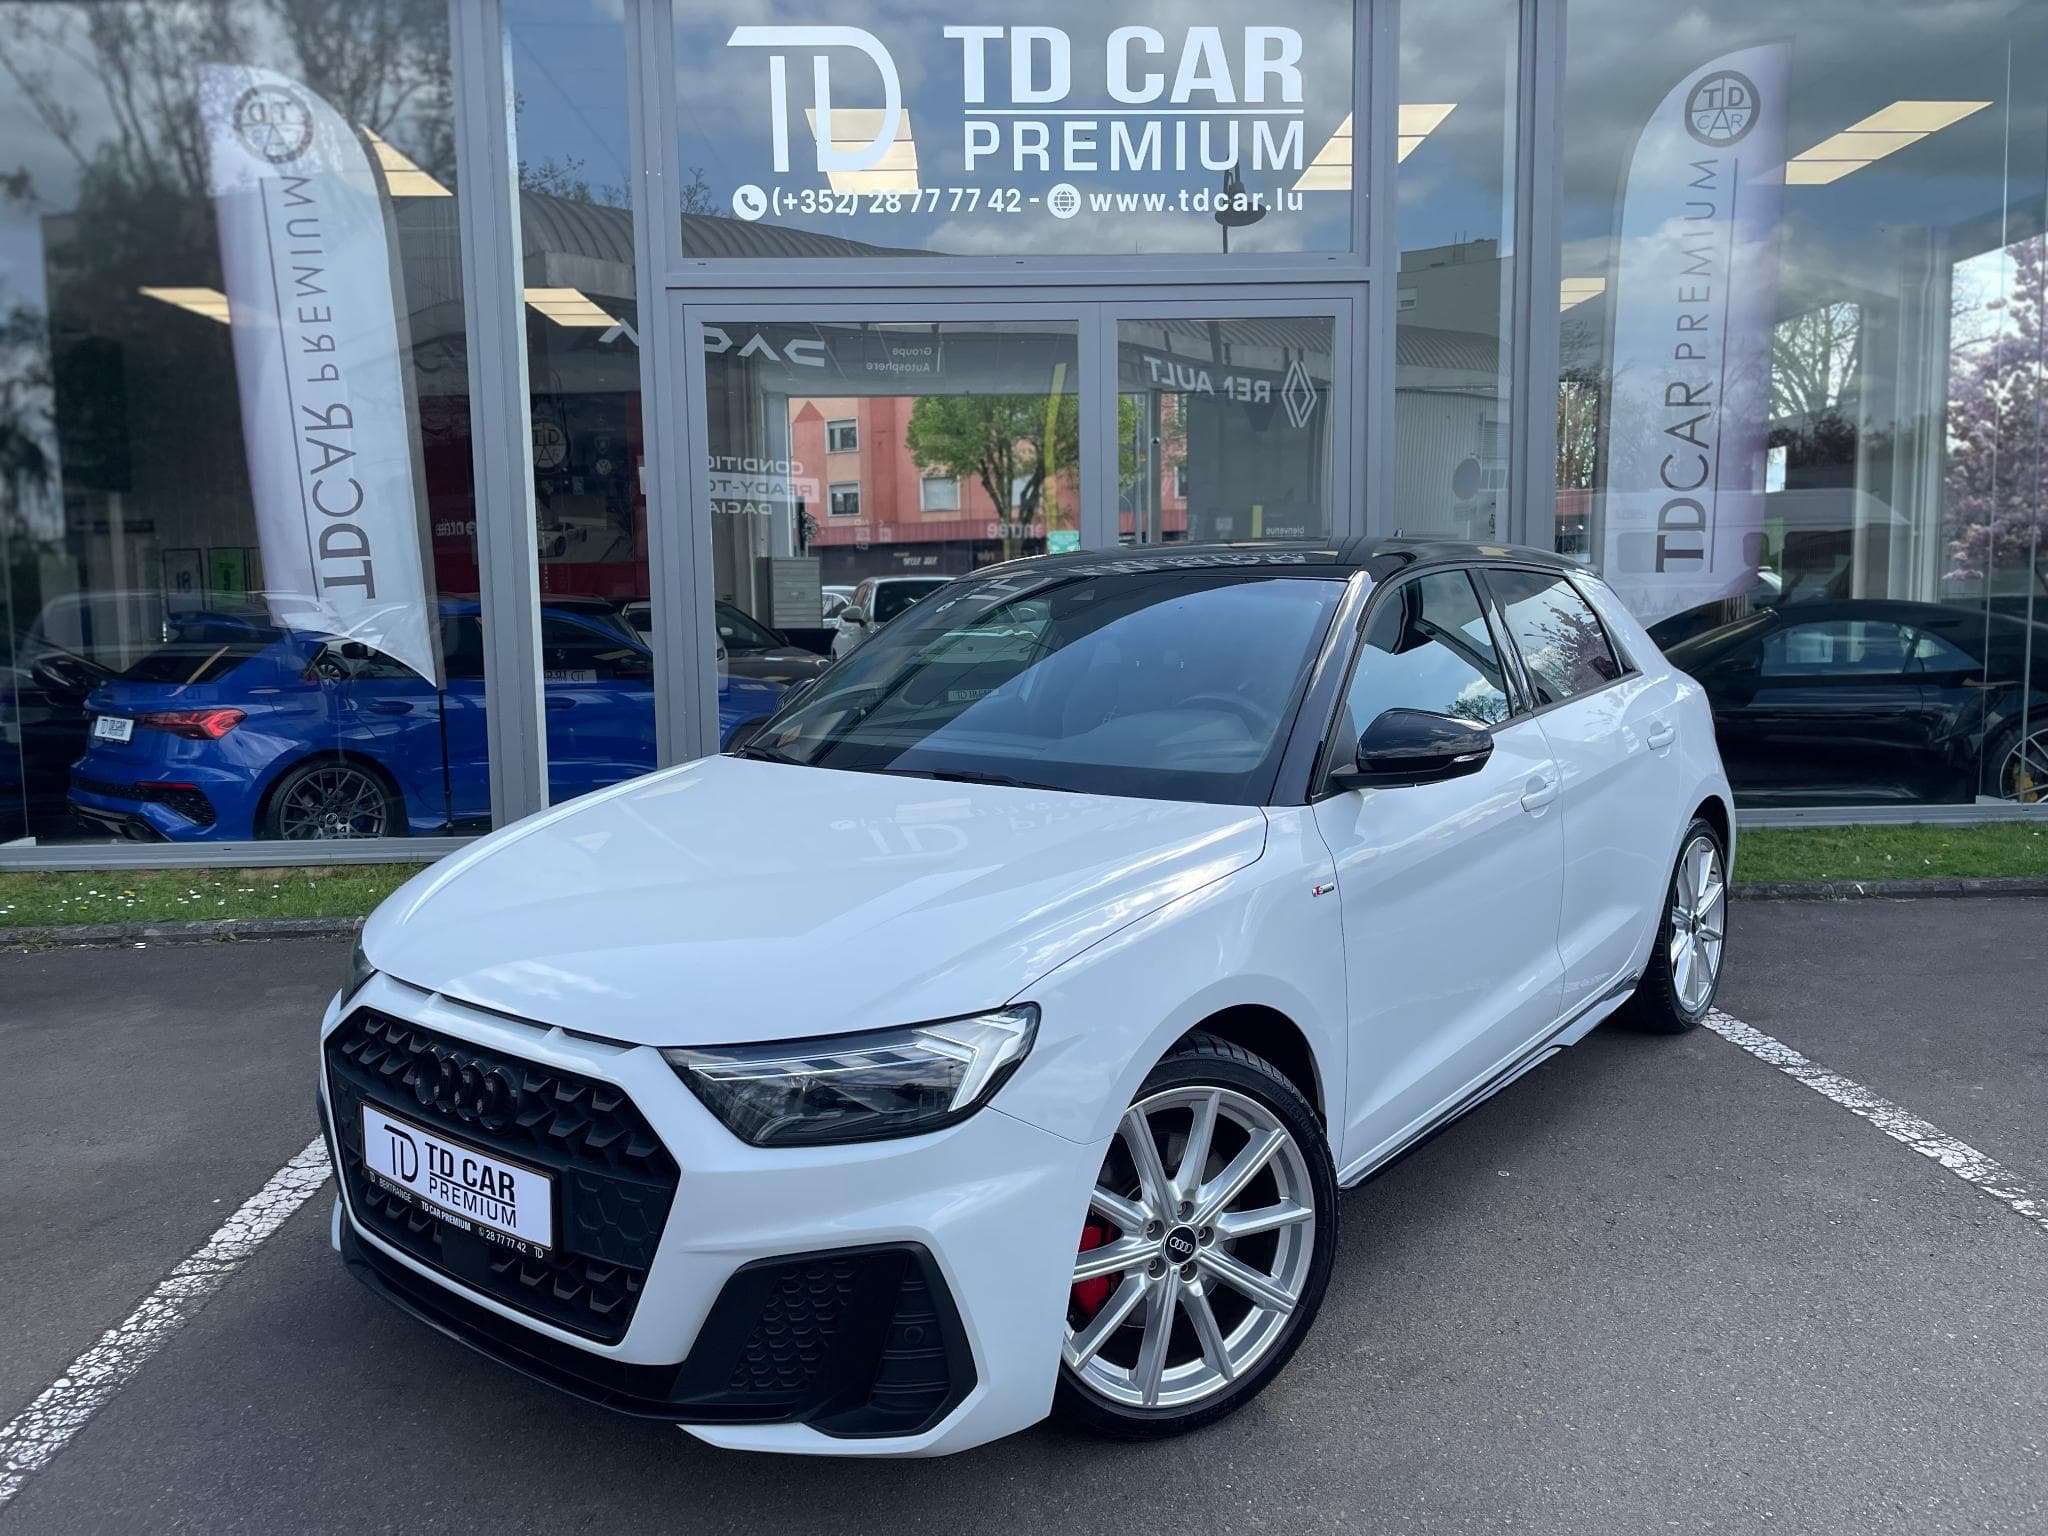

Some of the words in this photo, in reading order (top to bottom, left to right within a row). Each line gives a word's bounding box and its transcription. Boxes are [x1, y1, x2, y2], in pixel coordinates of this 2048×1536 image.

[943, 26, 1071, 104] TD
[1106, 26, 1304, 104] CAR
[727, 26, 902, 172] TD
[1696, 109, 1744, 138] CAR
[1702, 86, 1745, 108] TD
[964, 121, 1304, 171] PREMIUM
[772, 187, 859, 217] (+352)
[868, 188, 902, 214] 28
[911, 188, 941, 213] 77
[949, 188, 981, 212] 77
[988, 188, 1022, 213] 42
[1089, 188, 1304, 212] www.tdcar.lu
[1675, 159, 1719, 360] PREMIUM
[1656, 381, 1713, 573] TDCAR
[384, 1124, 419, 1183] TD
[425, 1141, 454, 1179] TD
[462, 1158, 515, 1203] CAR
[421, 1200, 429, 1212] TD
[429, 1206, 441, 1218] CAR
[441, 1212, 471, 1232] PREMIUM
[485, 1230, 495, 1241] 28
[429, 1177, 516, 1229] PREMIUM
